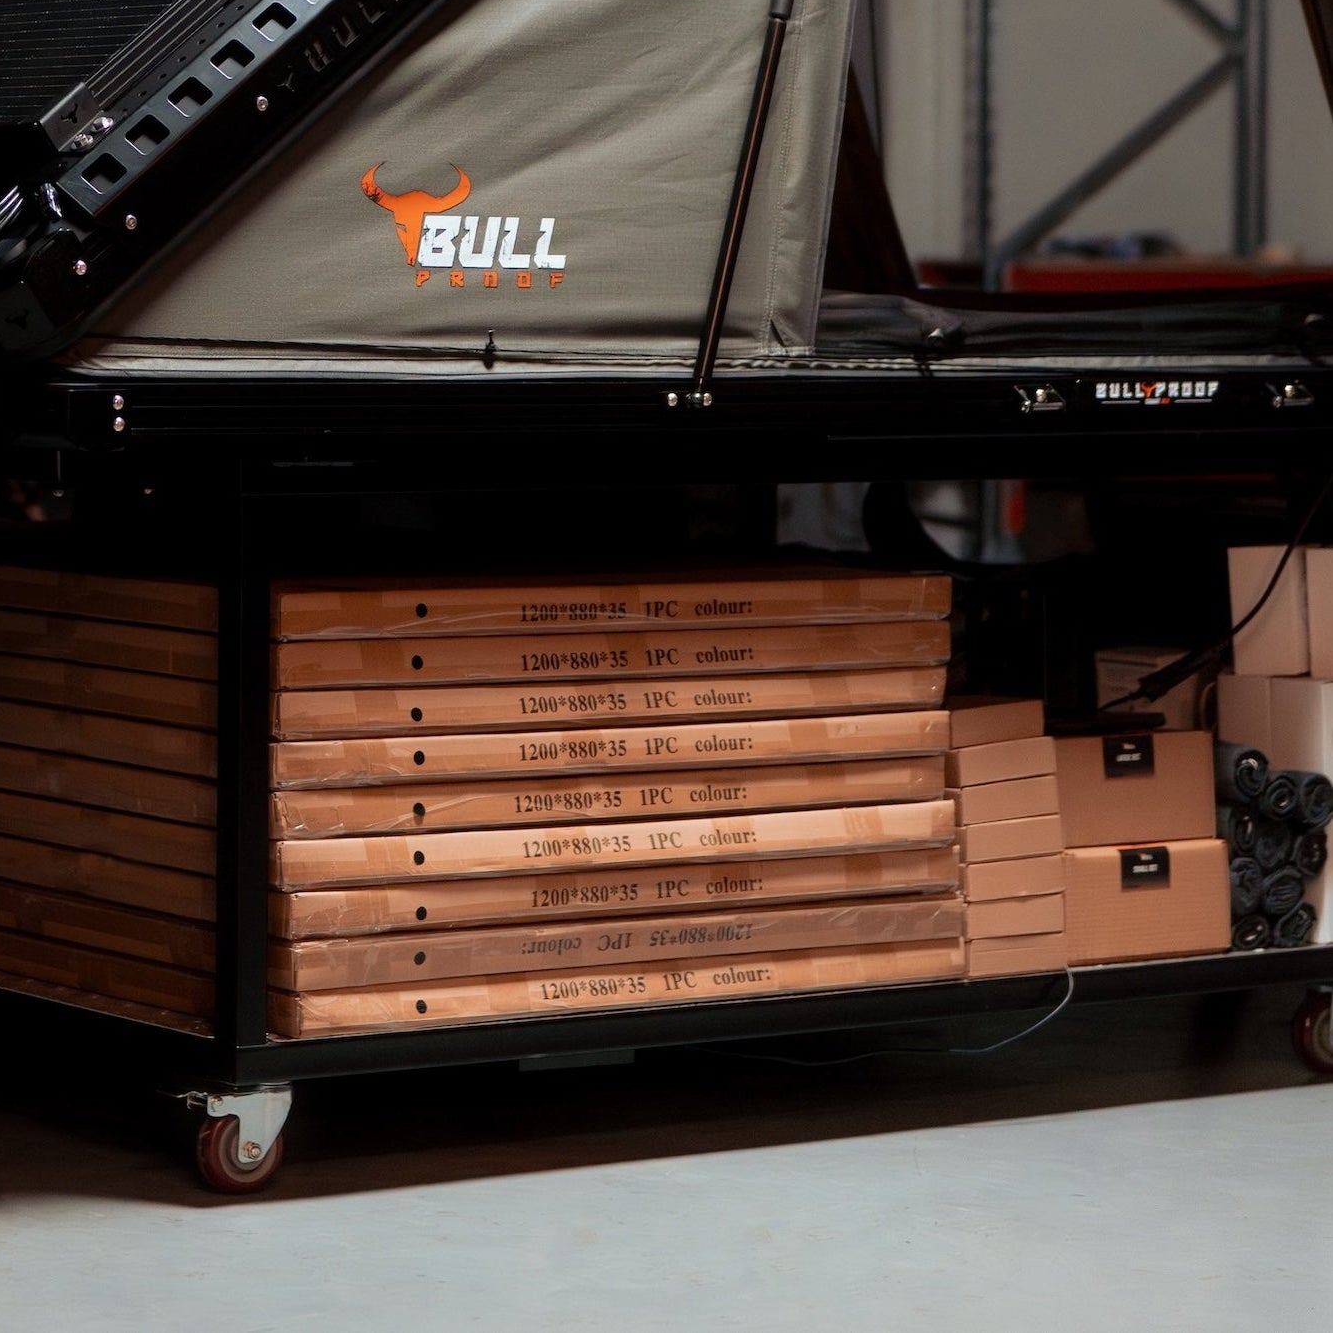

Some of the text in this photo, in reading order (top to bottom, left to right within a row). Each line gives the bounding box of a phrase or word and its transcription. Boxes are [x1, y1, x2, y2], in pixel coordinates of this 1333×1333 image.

[418, 215, 567, 269] BULL
[415, 270, 565, 289] PROOF
[643, 600, 679, 618] 1PC
[693, 598, 753, 617] colour:
[644, 647, 680, 667] 1PC
[695, 645, 754, 664] colour:
[643, 690, 678, 709] 1PC
[693, 688, 752, 706] colour:
[644, 736, 679, 756] 1PC
[694, 734, 753, 753] colour:
[639, 786, 673, 807] 1PC
[689, 784, 747, 803] colour:
[648, 832, 682, 850] 1PC
[699, 829, 756, 847] colour:
[656, 879, 690, 899] 1PC
[706, 876, 763, 895] colour:
[597, 932, 633, 952] 1PC
[663, 971, 697, 991] 1PC
[712, 967, 771, 986] colour:
